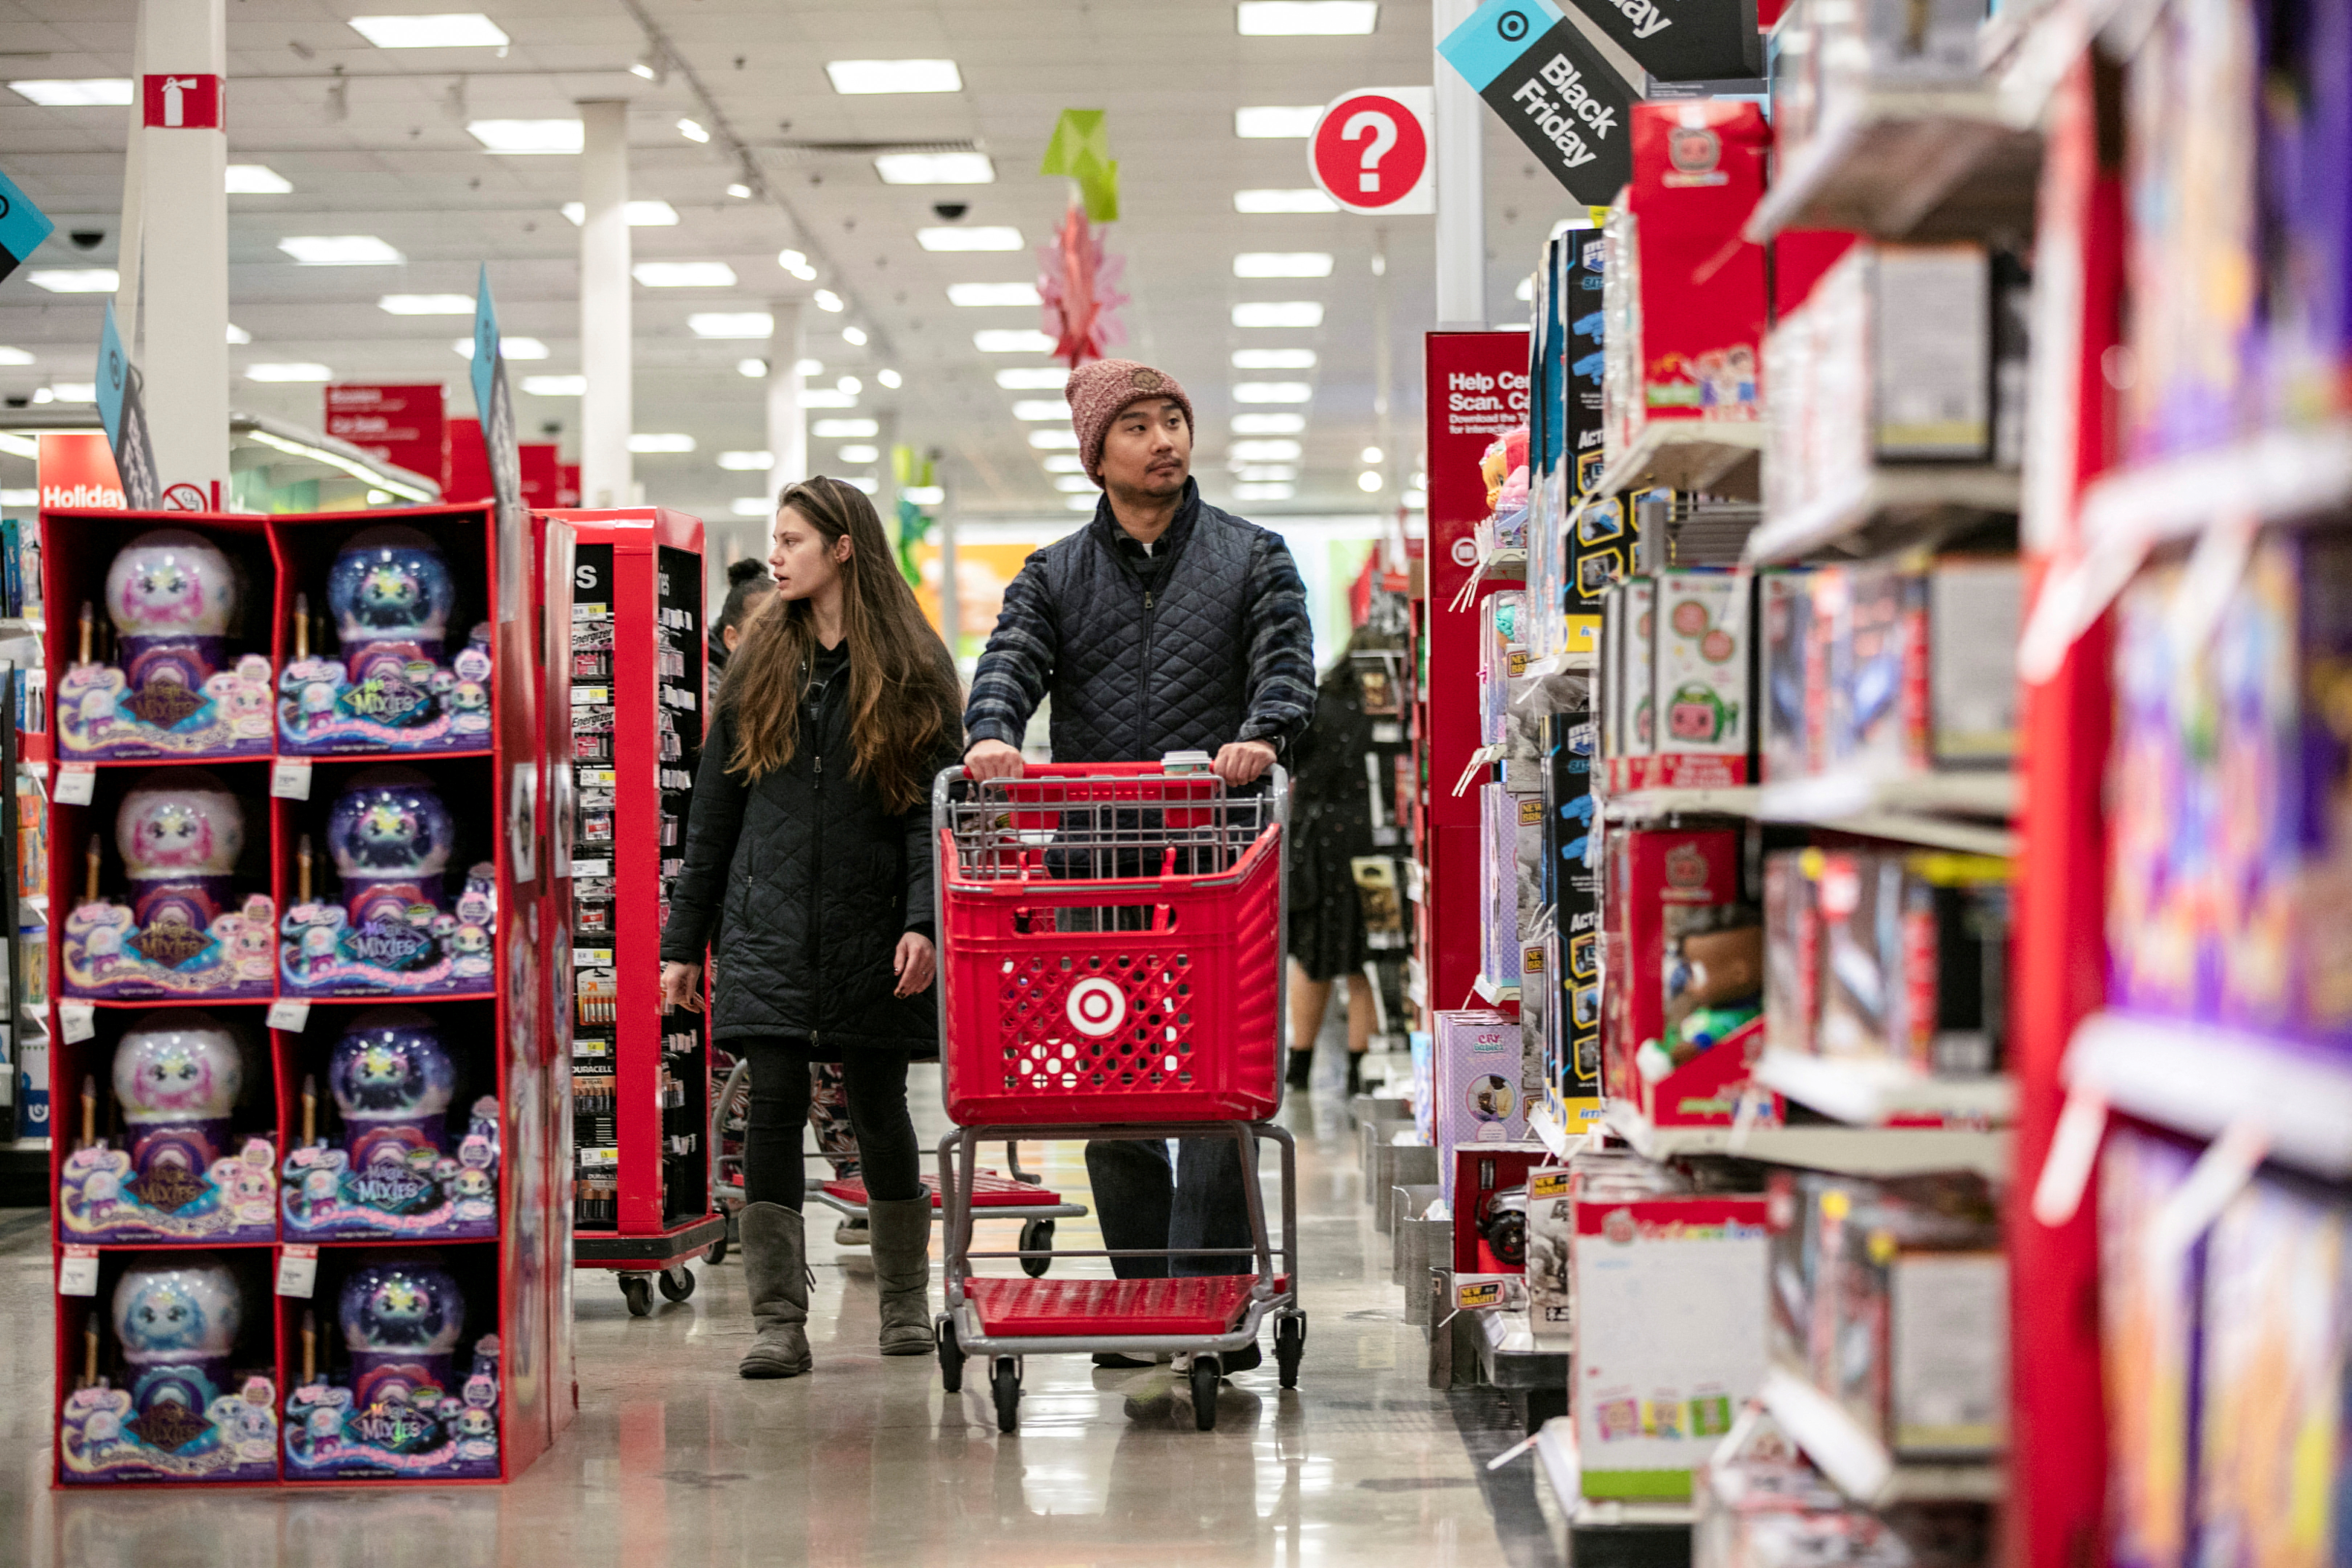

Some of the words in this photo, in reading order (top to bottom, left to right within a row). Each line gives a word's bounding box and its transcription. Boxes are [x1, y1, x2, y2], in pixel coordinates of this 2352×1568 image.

[1539, 53, 1617, 140] Black
[1512, 78, 1597, 168] Friday
[1449, 371, 1495, 394] Help
[1449, 392, 1504, 412] Scan.
[1449, 413, 1499, 424] Download
[1449, 424, 1463, 434] for
[43, 483, 127, 510] Holiday
[1462, 1286, 1482, 1297] NEW
